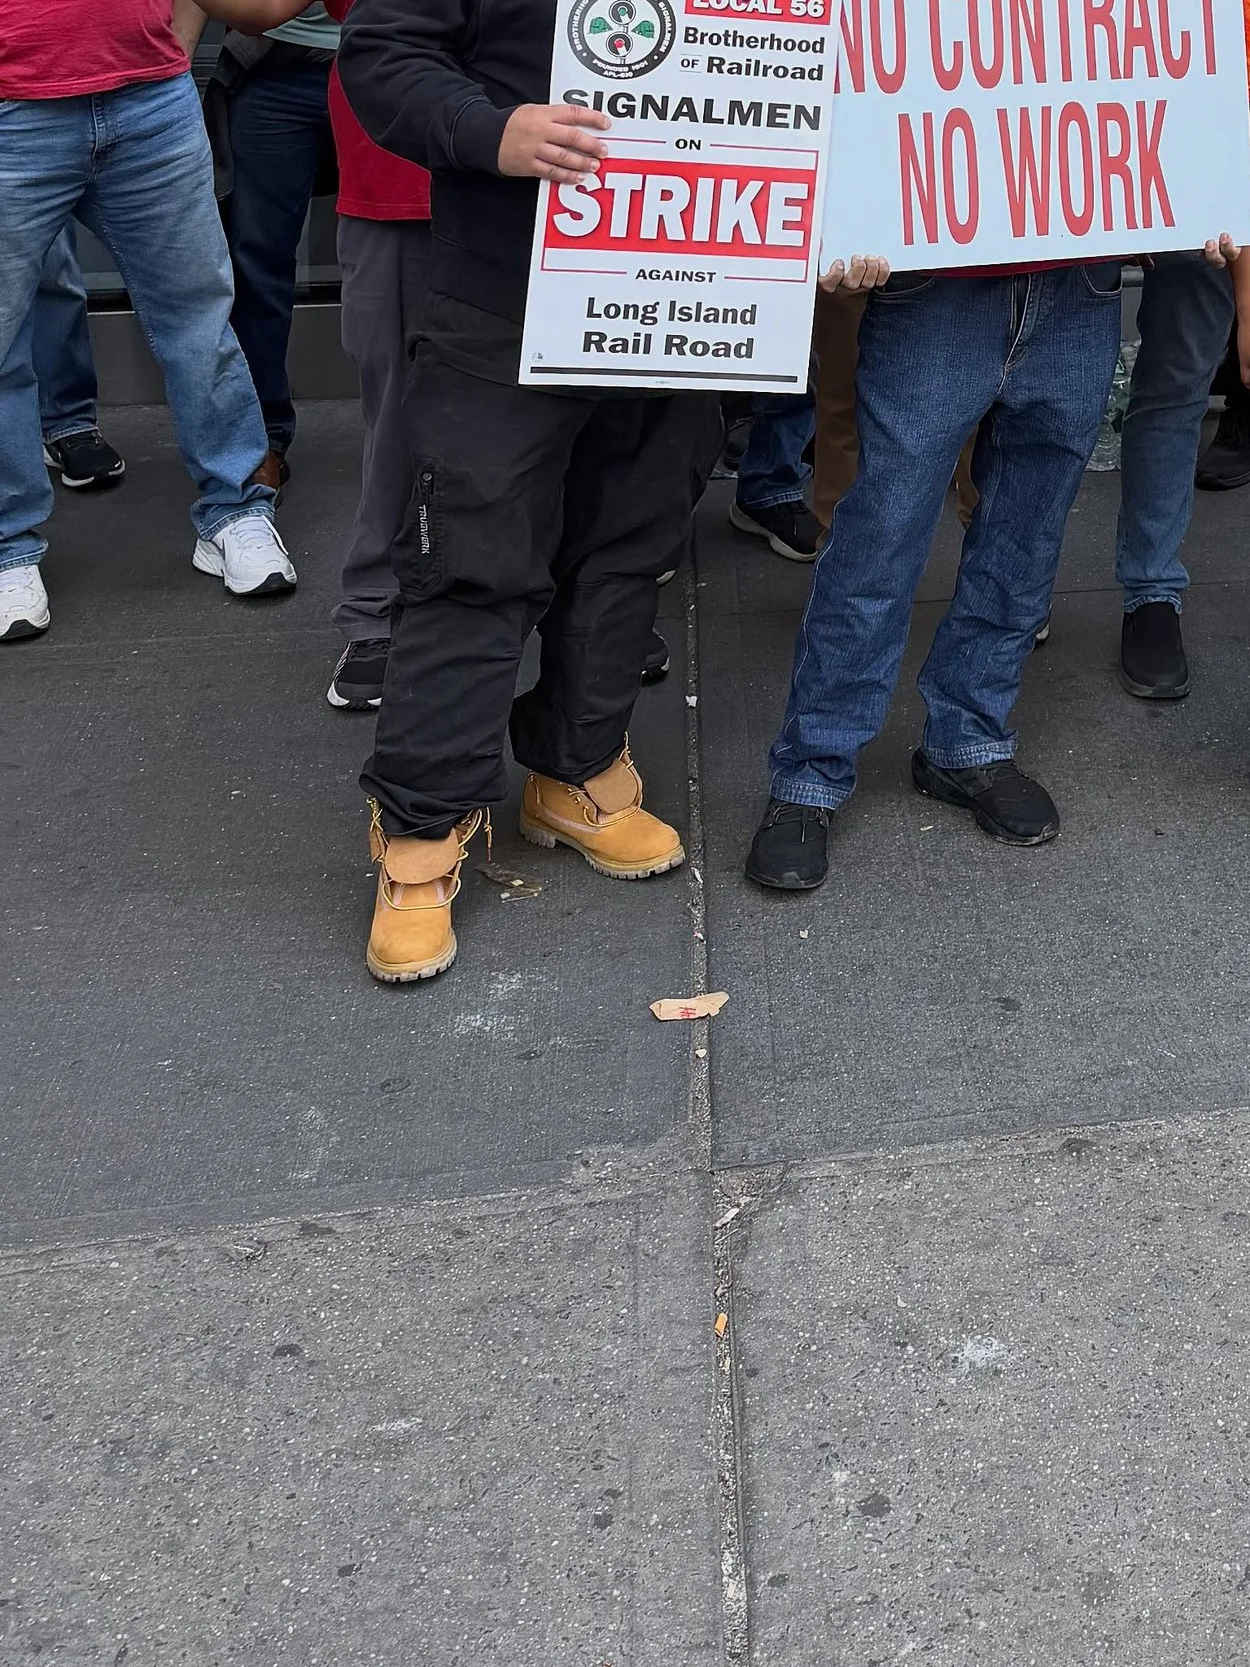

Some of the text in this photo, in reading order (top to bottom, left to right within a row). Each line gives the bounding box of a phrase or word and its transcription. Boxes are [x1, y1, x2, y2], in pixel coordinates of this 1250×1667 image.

[684, 27, 825, 54] Brotherhood
[681, 56, 824, 81] OF Railroad
[562, 88, 821, 130] SIGNALMEN
[675, 138, 701, 150] ON
[898, 99, 1176, 245] NO WORK
[553, 171, 809, 247] STRIKE
[635, 268, 716, 283] AGAINST
[586, 297, 757, 325] Long Island
[582, 331, 754, 359] Rail Road
[419, 504, 430, 554] TRUEWERK
